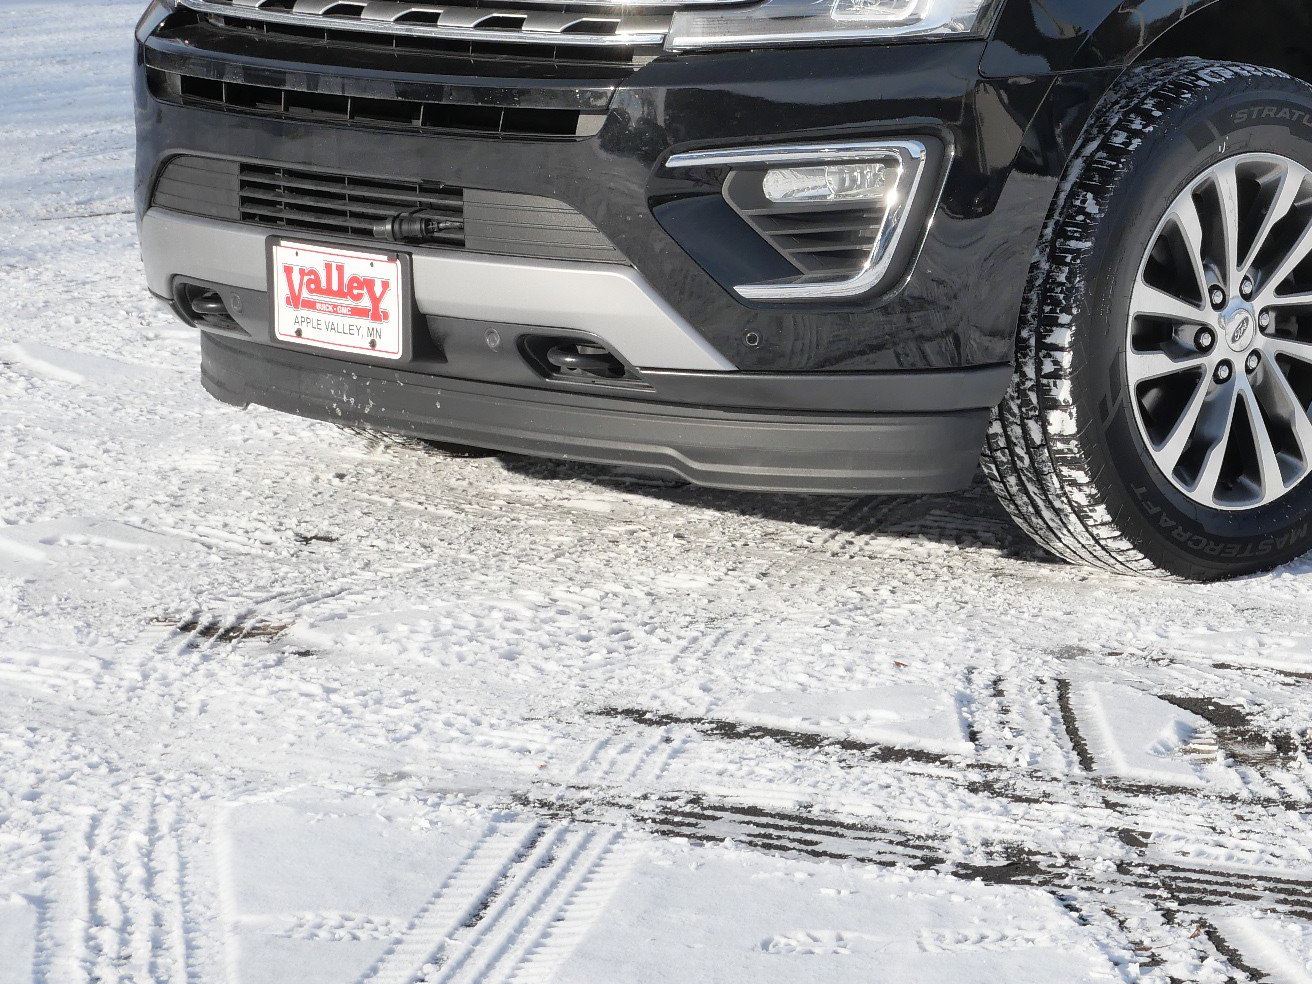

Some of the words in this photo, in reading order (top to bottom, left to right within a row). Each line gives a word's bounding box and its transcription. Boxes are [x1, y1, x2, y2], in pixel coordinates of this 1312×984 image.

[283, 262, 390, 323] Valley
[294, 315, 322, 331] APPLE
[324, 320, 364, 339] VALLEY,
[366, 326, 382, 340] MN
[1130, 483, 1309, 558] MASTERCRAFT
